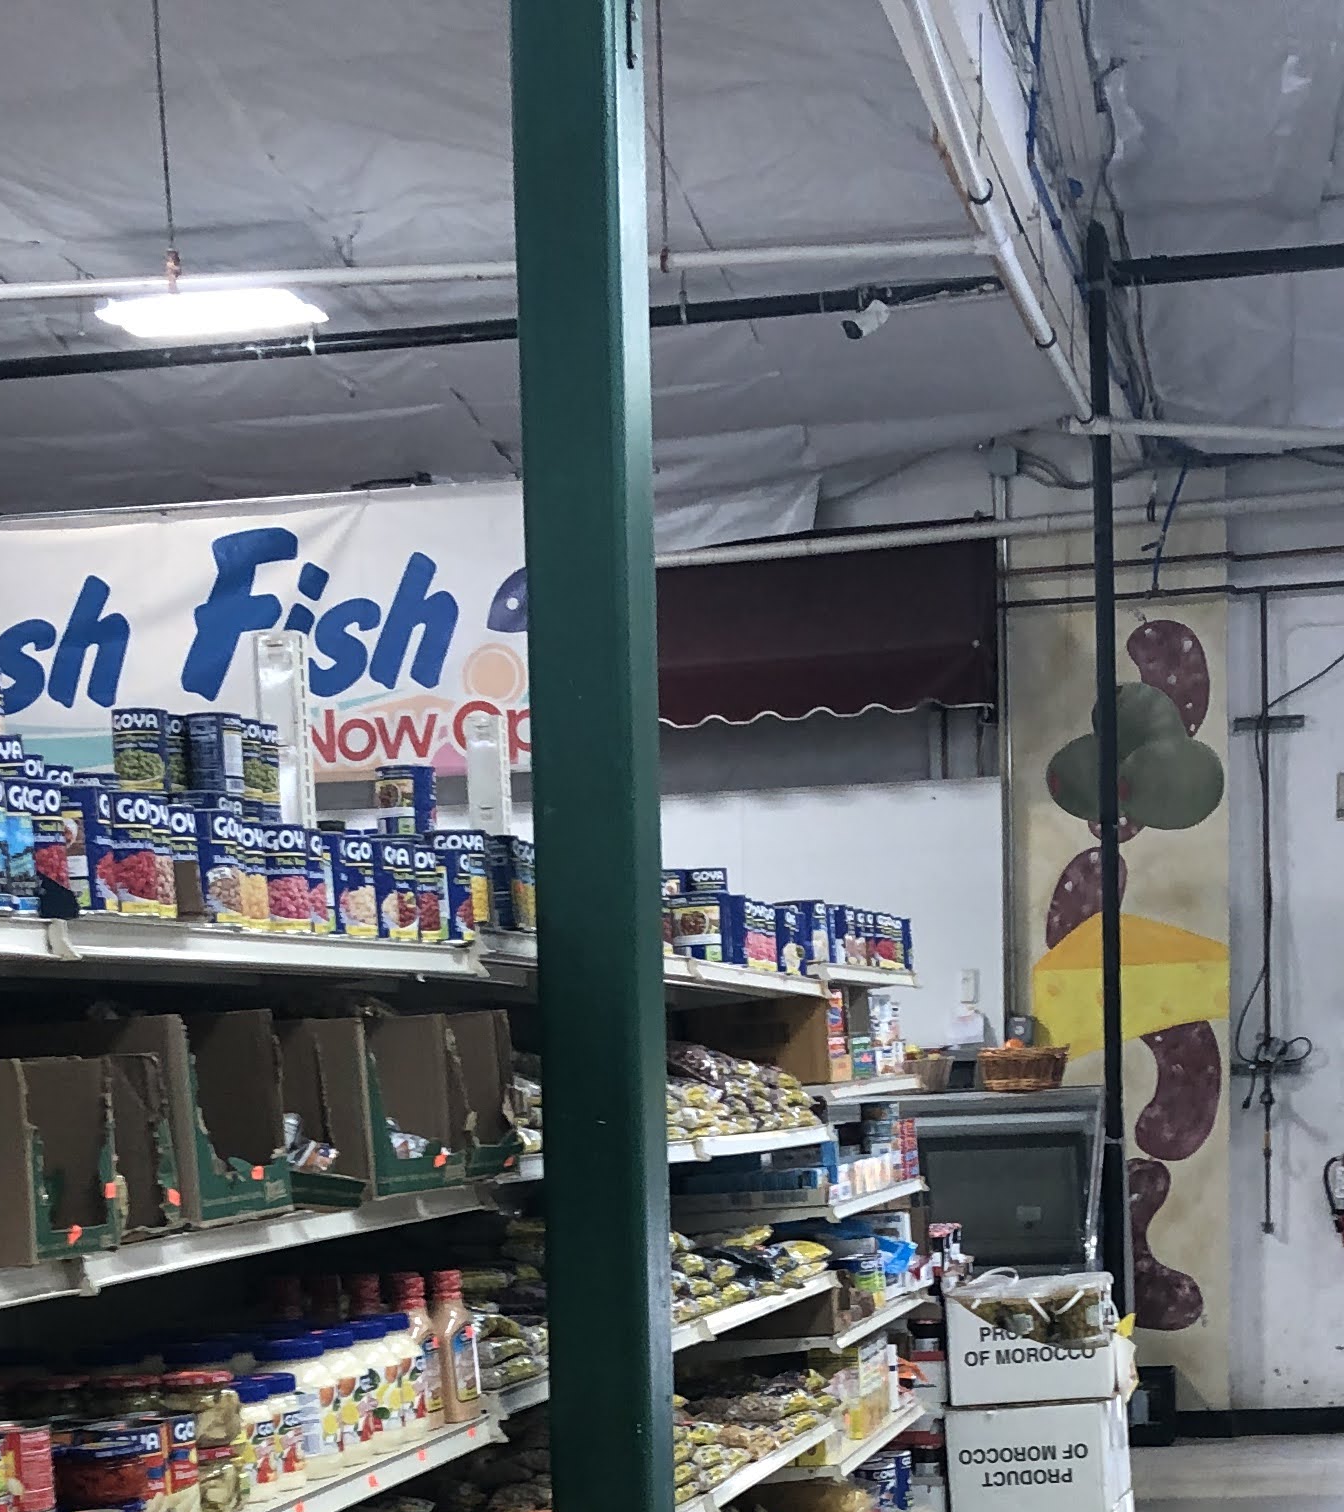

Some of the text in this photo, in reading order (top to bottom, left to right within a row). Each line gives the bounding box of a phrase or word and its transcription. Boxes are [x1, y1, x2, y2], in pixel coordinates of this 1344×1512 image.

[182, 527, 460, 702] Fish
[27, 788, 60, 813] GO
[116, 798, 150, 821] GO
[347, 841, 372, 861] GO
[434, 834, 484, 850] GOYA
[964, 1351, 991, 1367] OF
[175, 1420, 195, 1440] GO
[959, 1443, 1089, 1465] OF MOROCCO
[982, 1468, 1073, 1488] PRODUCT
